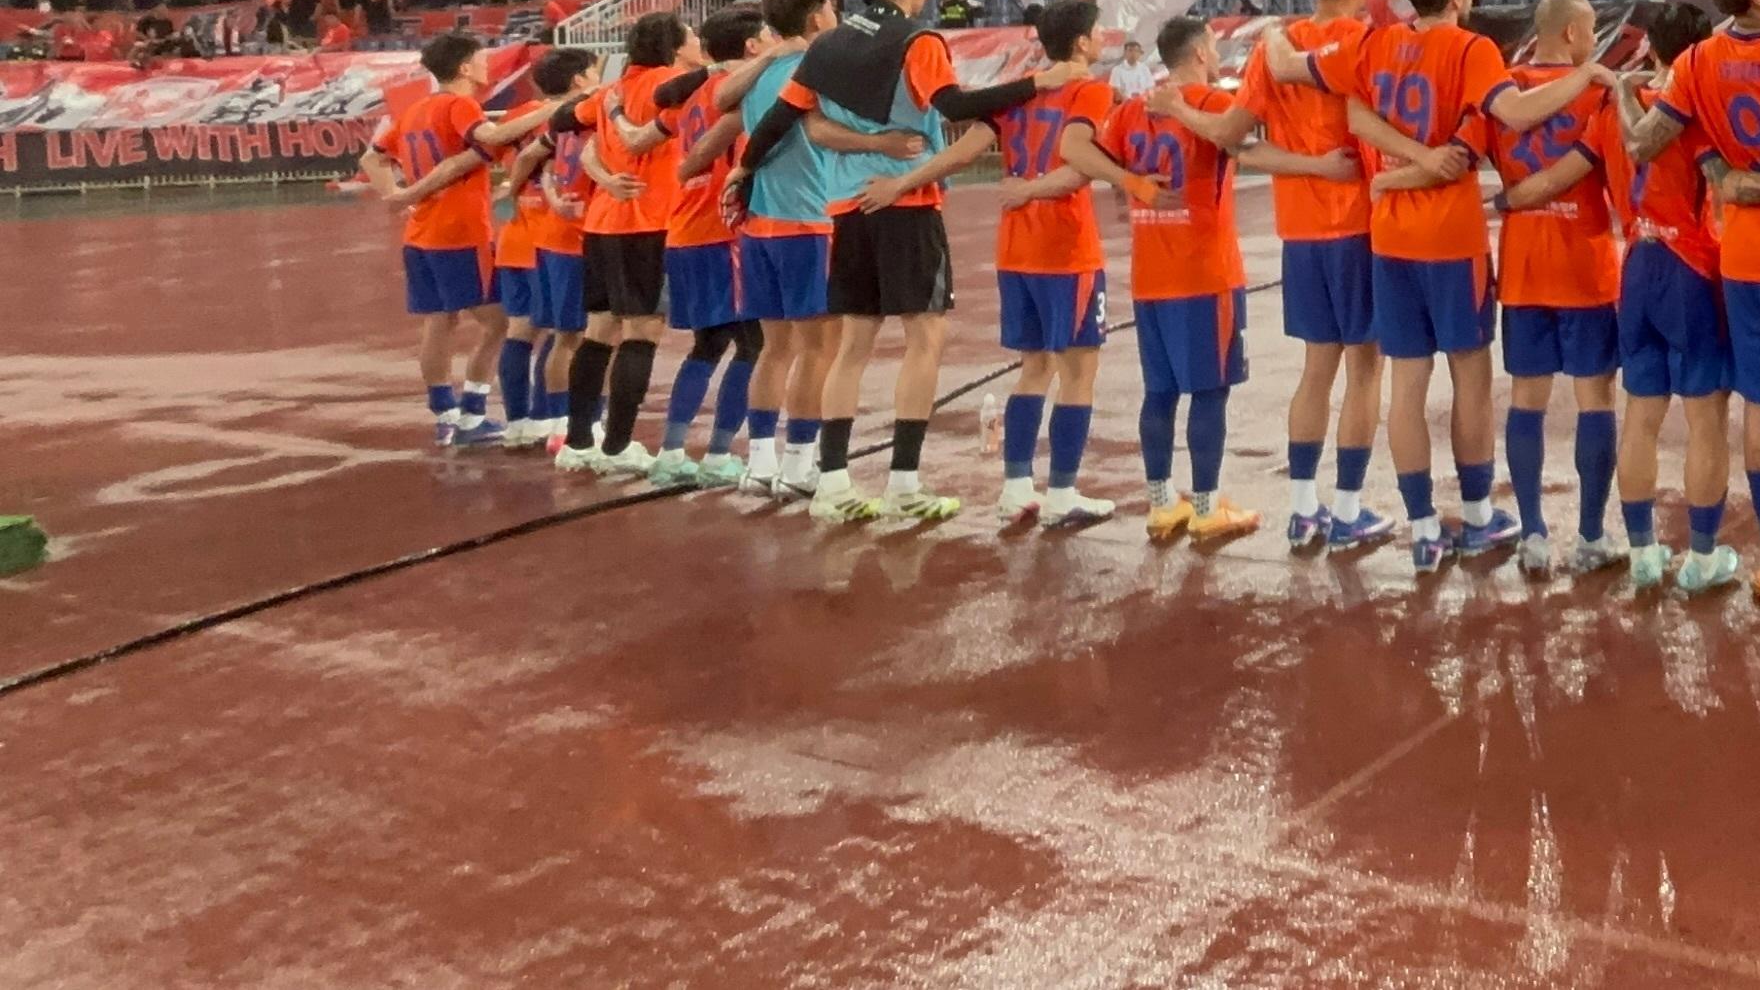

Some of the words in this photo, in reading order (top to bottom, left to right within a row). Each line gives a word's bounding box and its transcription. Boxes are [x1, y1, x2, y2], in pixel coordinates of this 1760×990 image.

[1006, 106, 1064, 176] 37
[1372, 70, 1435, 146] 19
[46, 125, 148, 169] LIVE
[152, 122, 272, 163] WITH
